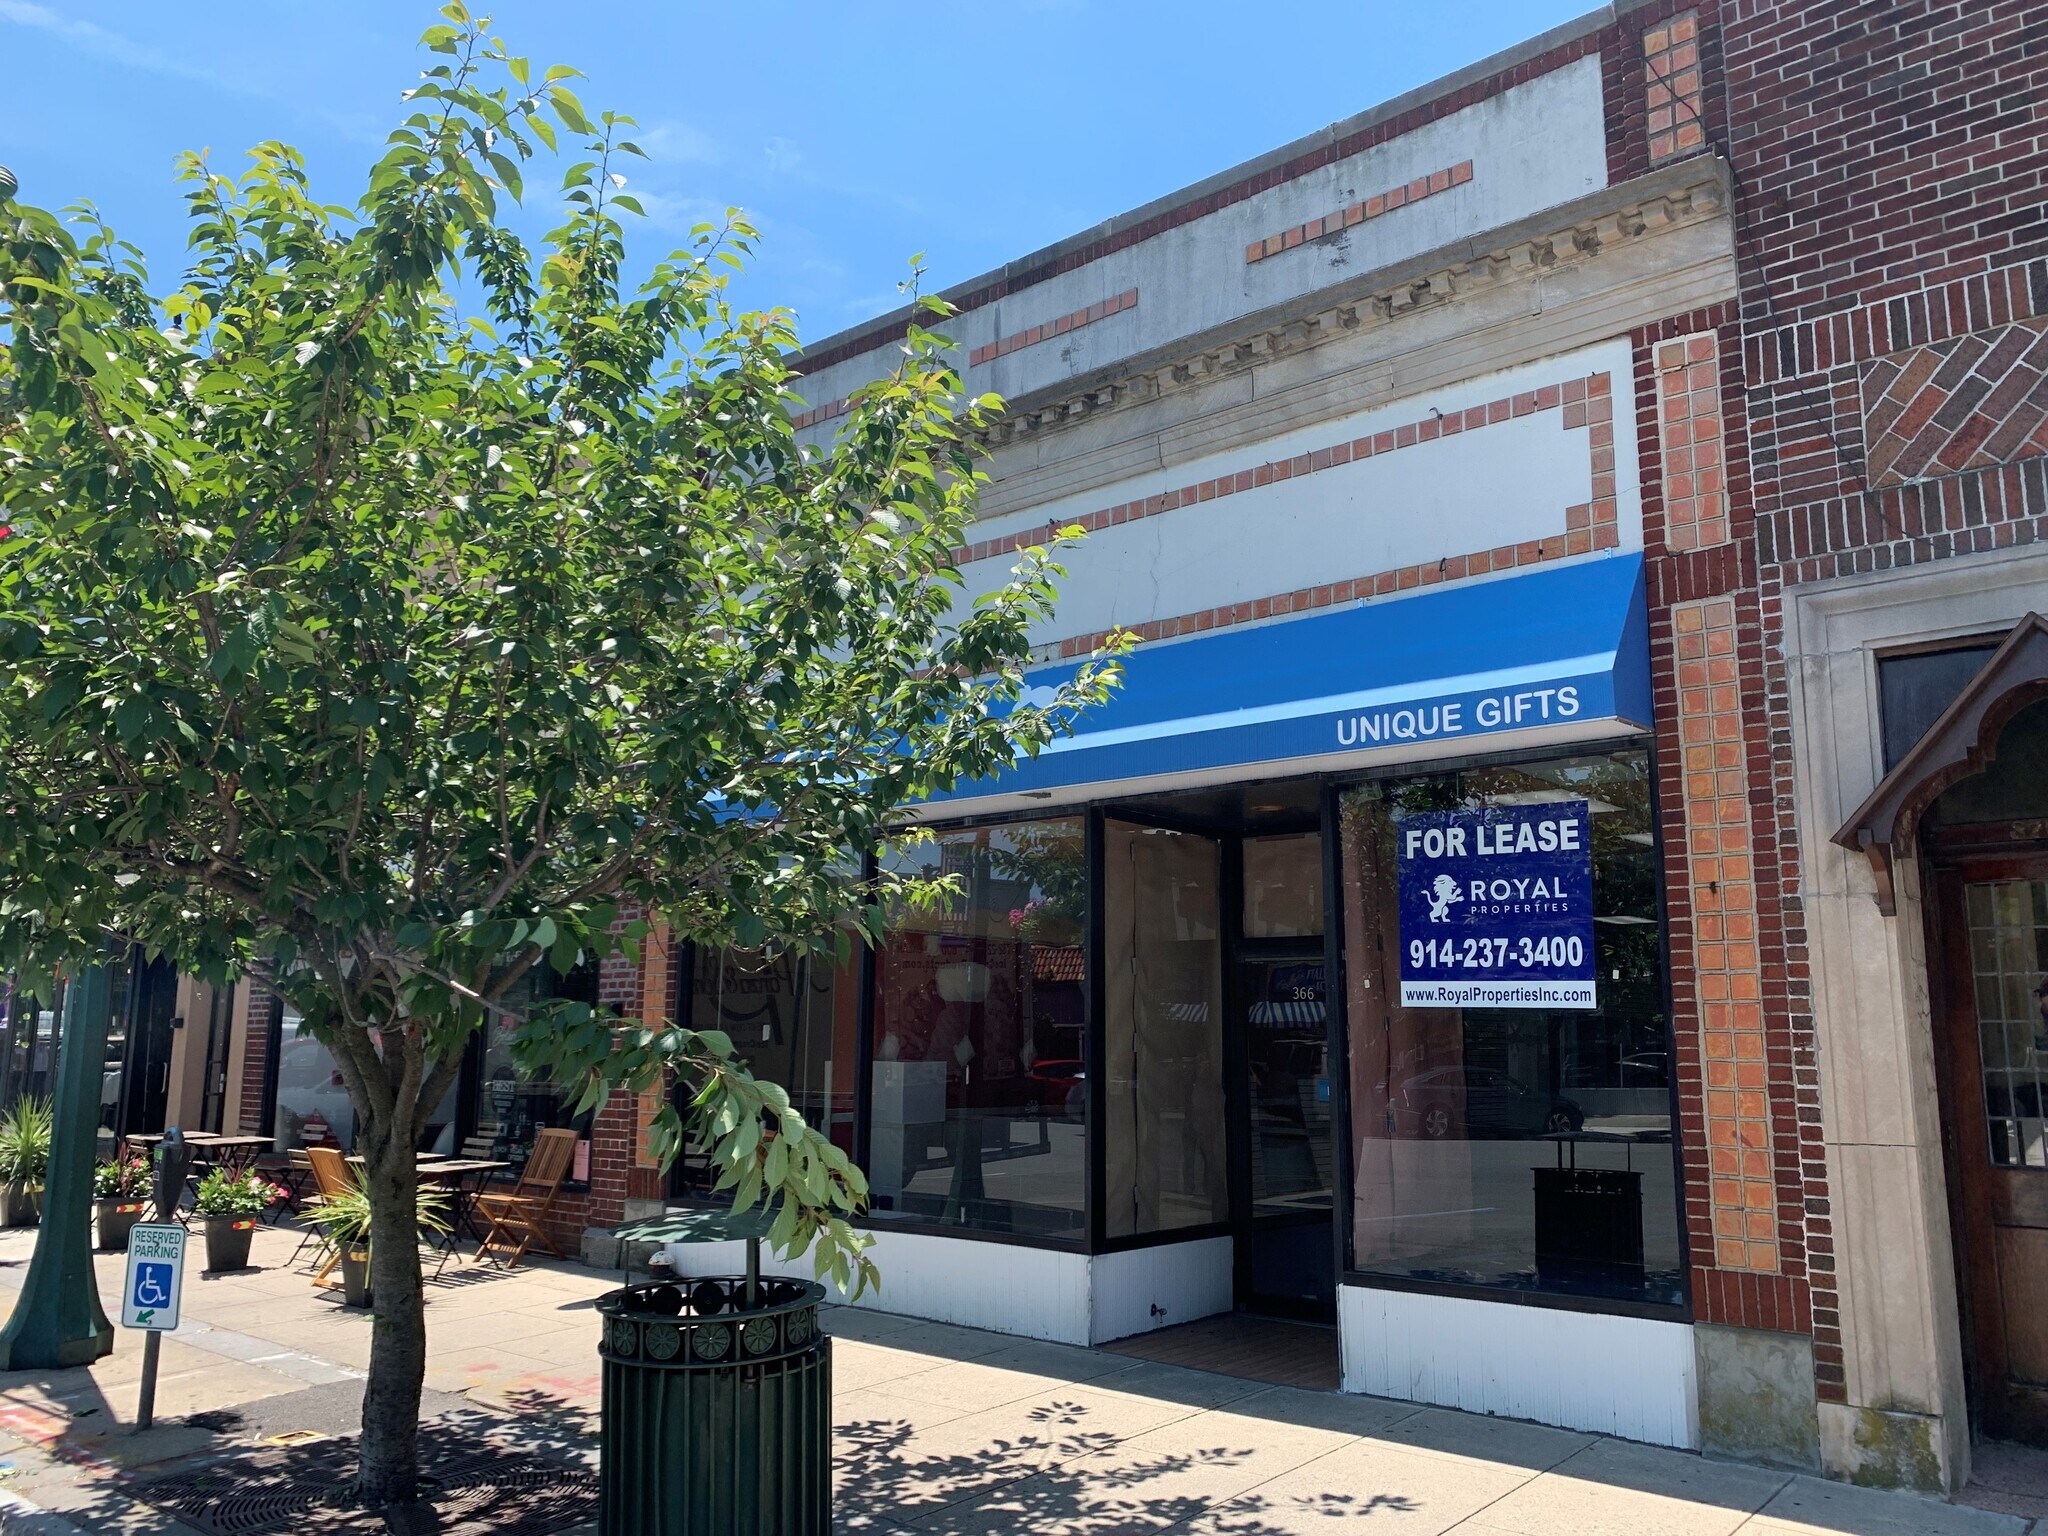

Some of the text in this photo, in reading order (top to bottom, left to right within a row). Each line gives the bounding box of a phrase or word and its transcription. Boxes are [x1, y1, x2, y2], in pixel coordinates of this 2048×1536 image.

[1337, 686, 1579, 745] UNIQUE GIFTS
[1406, 819, 1580, 859] FOR LEASE
[1471, 877, 1568, 901] ROYAL
[1471, 903, 1568, 914] PROPERTIES
[1410, 936, 1583, 968] 914-237-3400
[1293, 986, 1315, 1000] 366
[1406, 987, 1591, 1004] www.RoyalPropertiesInc.com
[492, 1080, 515, 1092] BEST
[135, 1230, 181, 1245] RESERVED
[134, 1245, 178, 1259] PARKING
